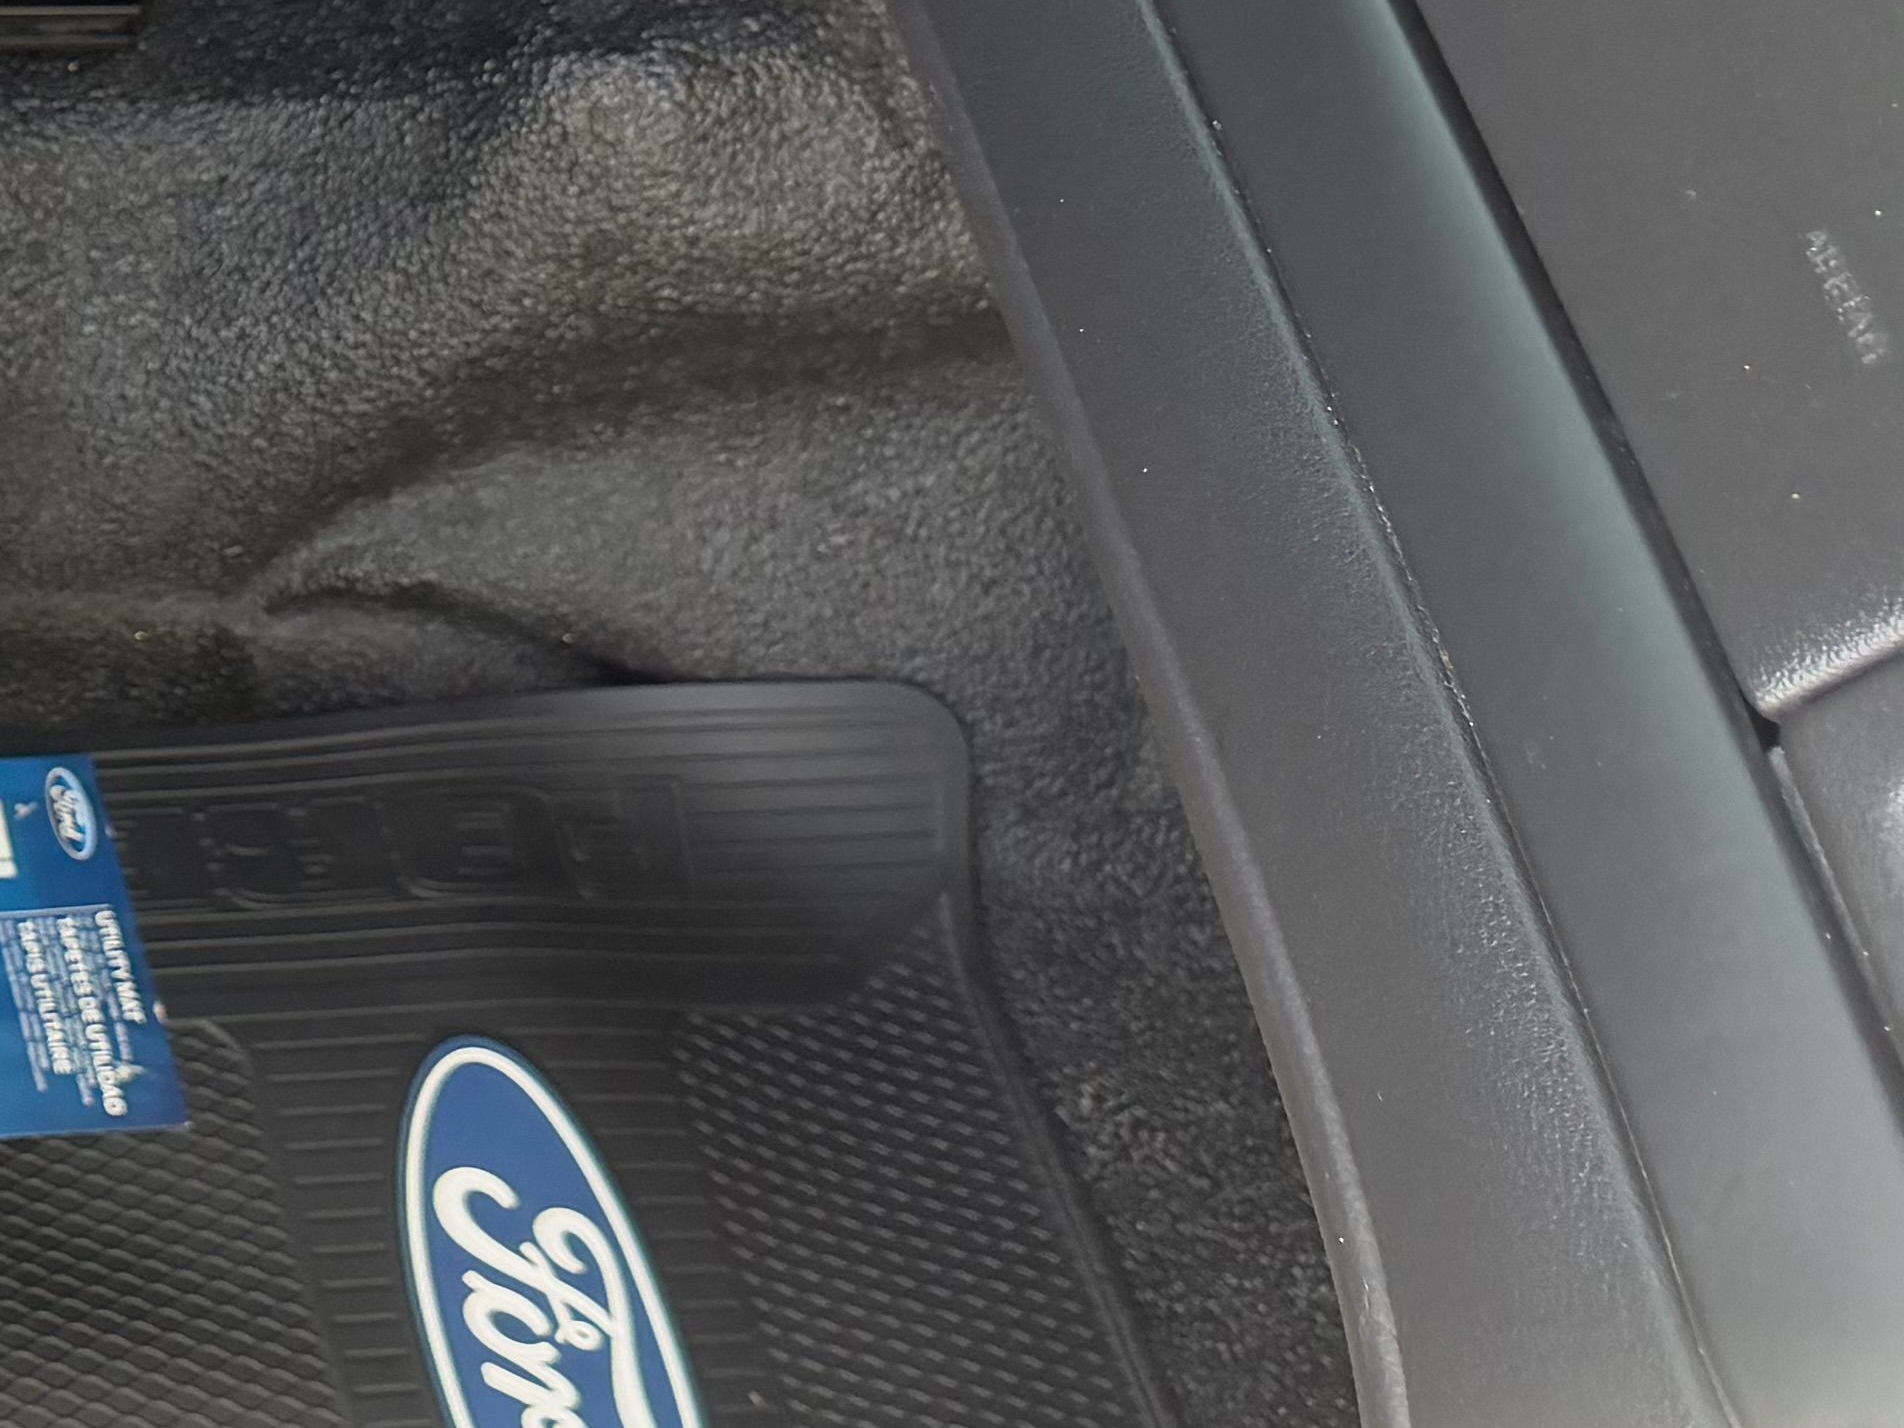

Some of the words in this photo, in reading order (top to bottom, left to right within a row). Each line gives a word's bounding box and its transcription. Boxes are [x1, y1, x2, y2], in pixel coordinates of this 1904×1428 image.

[17, 920, 46, 974] TAPIS
[56, 916, 93, 997] TAPETES
[94, 909, 134, 981] UTILITY
[30, 973, 73, 1075] UTILITAIRE
[77, 996, 104, 1024] DE
[112, 980, 147, 1024] MAT
[85, 1023, 128, 1117] UTILIDAD
